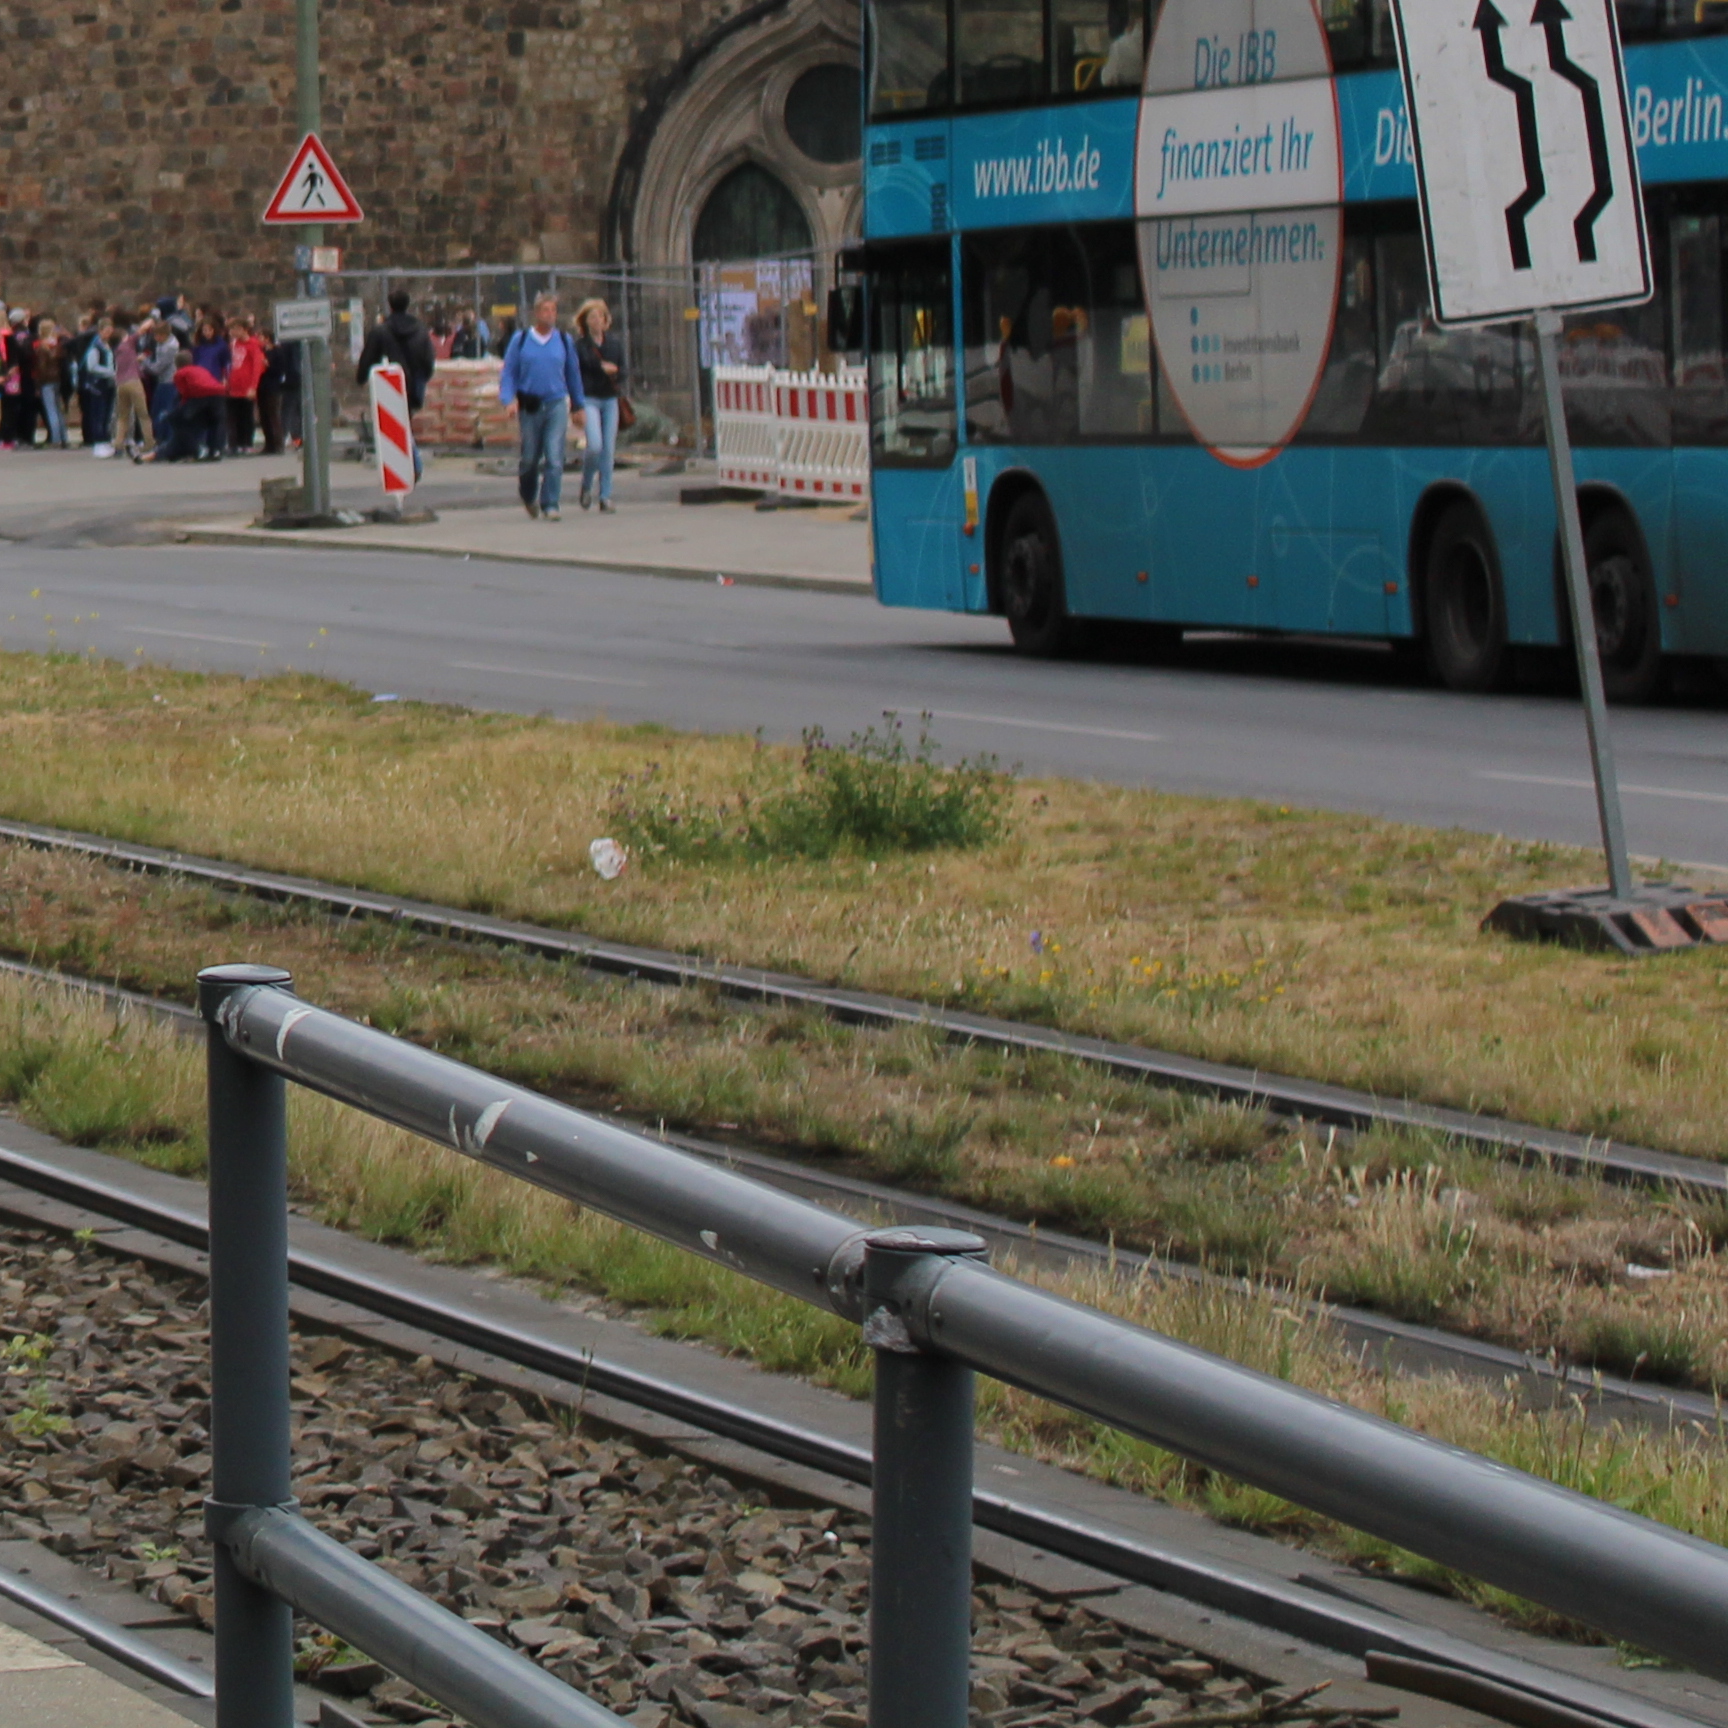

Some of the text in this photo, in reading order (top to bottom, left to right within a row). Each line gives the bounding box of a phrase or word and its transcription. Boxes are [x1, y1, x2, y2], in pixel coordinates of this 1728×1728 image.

[1195, 29, 1275, 86] Die IBB
[974, 135, 1101, 198] www.ibb.de
[1156, 117, 1314, 199] finanziert Ihr
